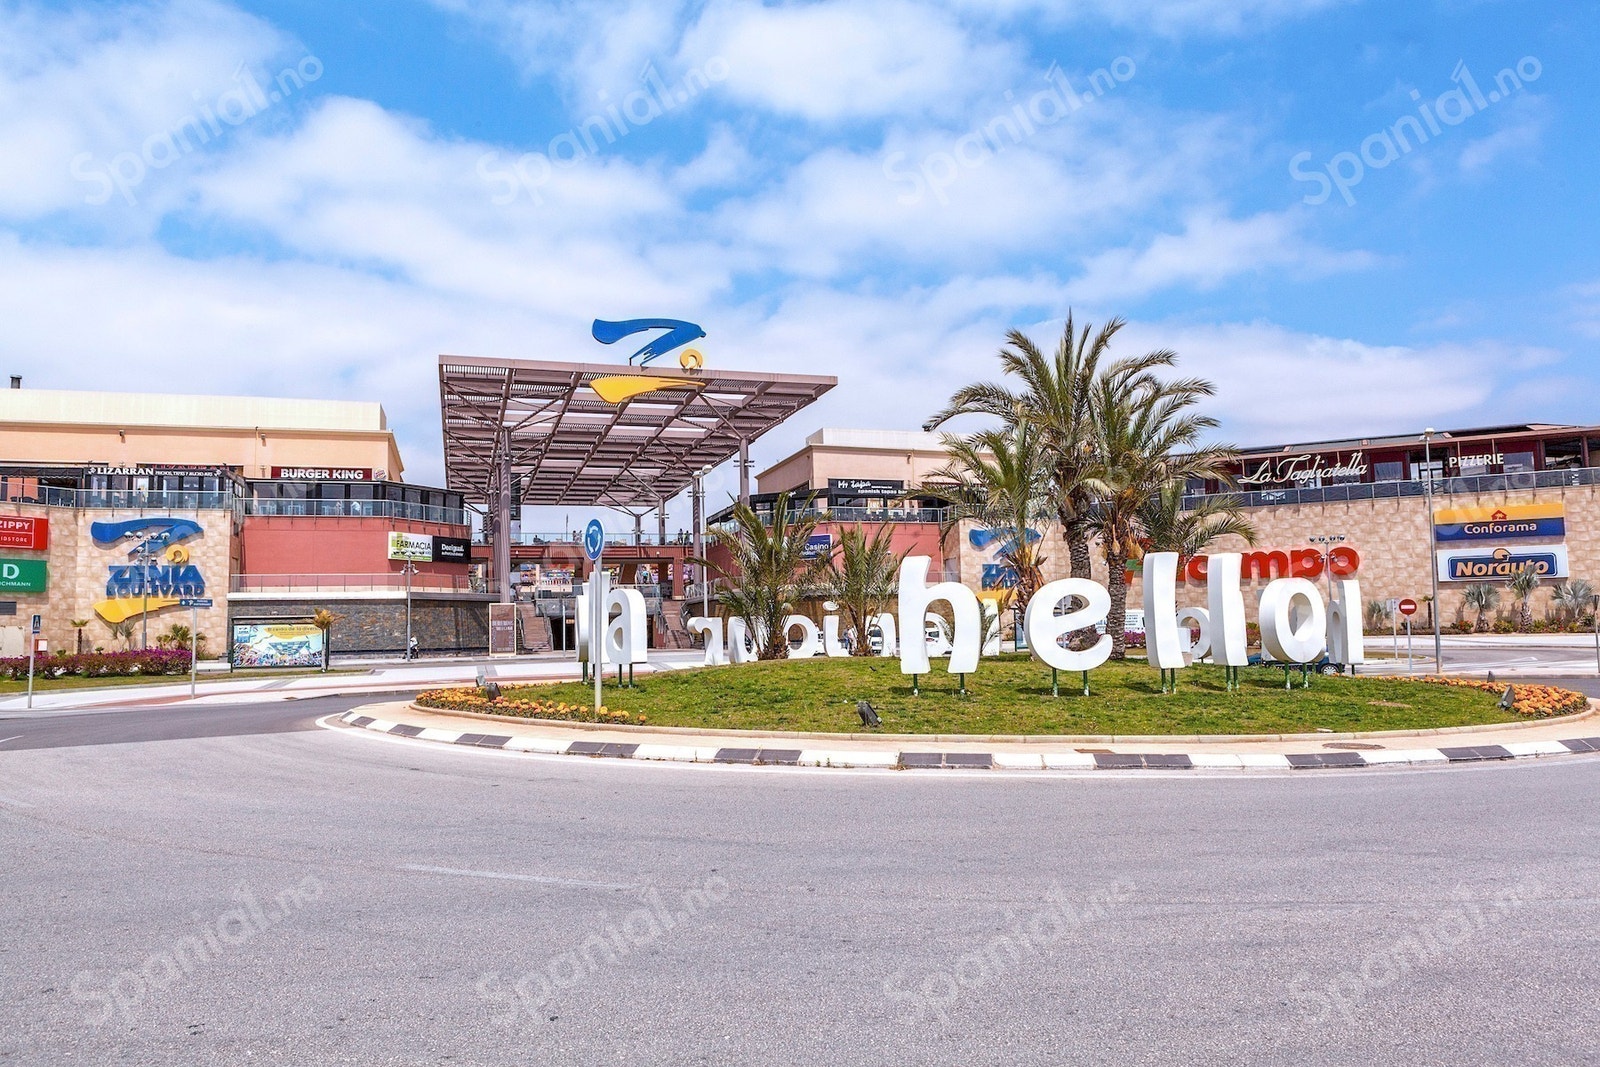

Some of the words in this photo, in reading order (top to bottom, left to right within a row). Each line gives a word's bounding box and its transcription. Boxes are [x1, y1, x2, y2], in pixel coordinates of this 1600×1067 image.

[1449, 453, 1504, 468] PIZZERIE
[97, 467, 154, 476] LIZARRAN
[280, 468, 329, 479] BURGER
[332, 469, 364, 480] KING
[1237, 460, 1272, 484] La
[1273, 452, 1368, 484] Tagliatella
[1464, 522, 1537, 534] Conforama
[396, 540, 432, 550] FARMACIA
[804, 543, 829, 551] Casino
[1456, 559, 1549, 577] Norauto
[107, 565, 205, 585] ZENIA
[106, 584, 205, 597] BOULEVARD
[898, 552, 1327, 674] hello
